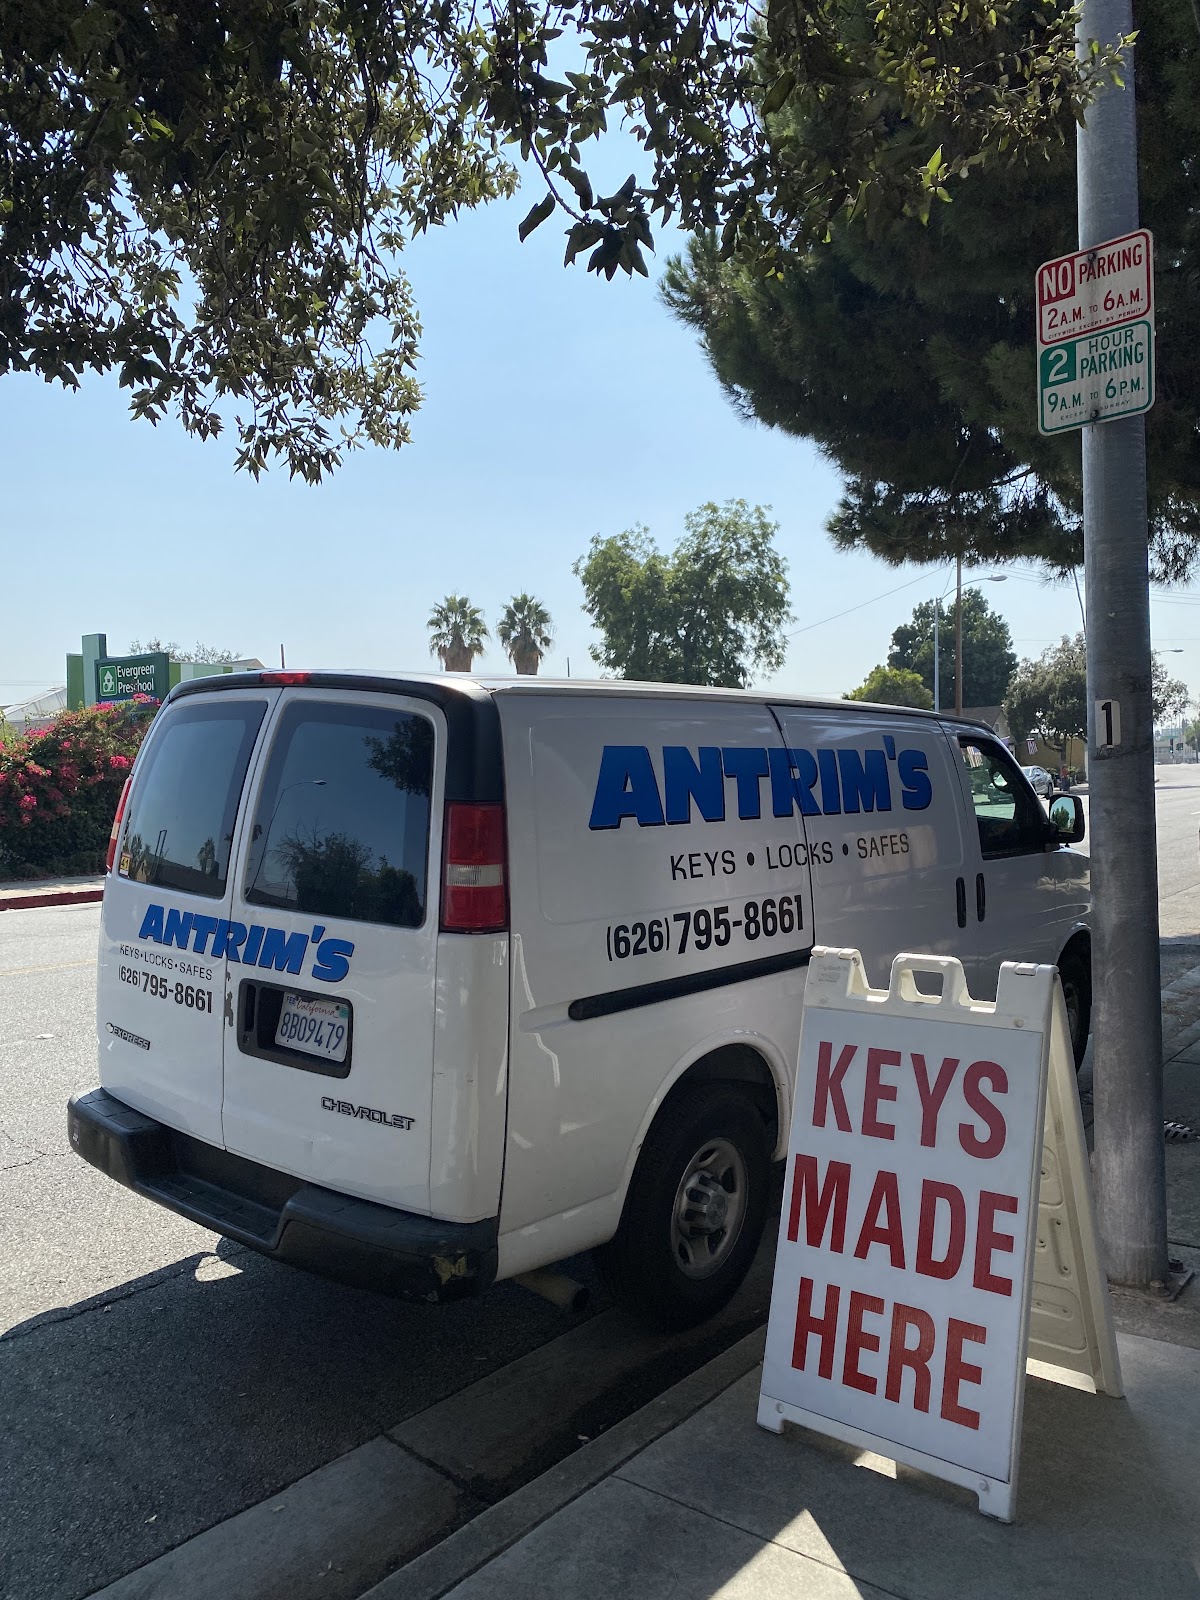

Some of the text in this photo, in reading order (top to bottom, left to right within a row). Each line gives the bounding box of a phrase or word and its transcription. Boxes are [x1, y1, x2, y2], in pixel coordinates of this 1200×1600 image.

[1043, 243, 1143, 301] NO PARKING
[1048, 307, 1142, 339] CITYWIDE EXCEPT BY PERMIT
[1089, 304, 1098, 314] TO
[1089, 328, 1134, 354] HOUR
[1048, 342, 1144, 383] 2 PARKING
[1060, 399, 1130, 421] EXCEPT SUNDAY
[1090, 391, 1099, 400] TO
[118, 664, 154, 680] Evergreen
[1101, 701, 1113, 747] 1
[588, 735, 933, 830] ANTRIM'S
[670, 833, 909, 880] KEYS LOCKS SAFES
[119, 943, 213, 981] KEYS LOCKS SAFES
[138, 903, 355, 983] ANTRIM'S
[296, 997, 339, 1018] California
[113, 1025, 151, 1051] EXPRESS
[280, 1011, 345, 1051] 8B09479
[321, 1096, 415, 1131] CHEVROLET
[811, 1041, 1009, 1160] KEYS
[787, 1153, 1019, 1297] MADE
[791, 1276, 987, 1431] HERE
